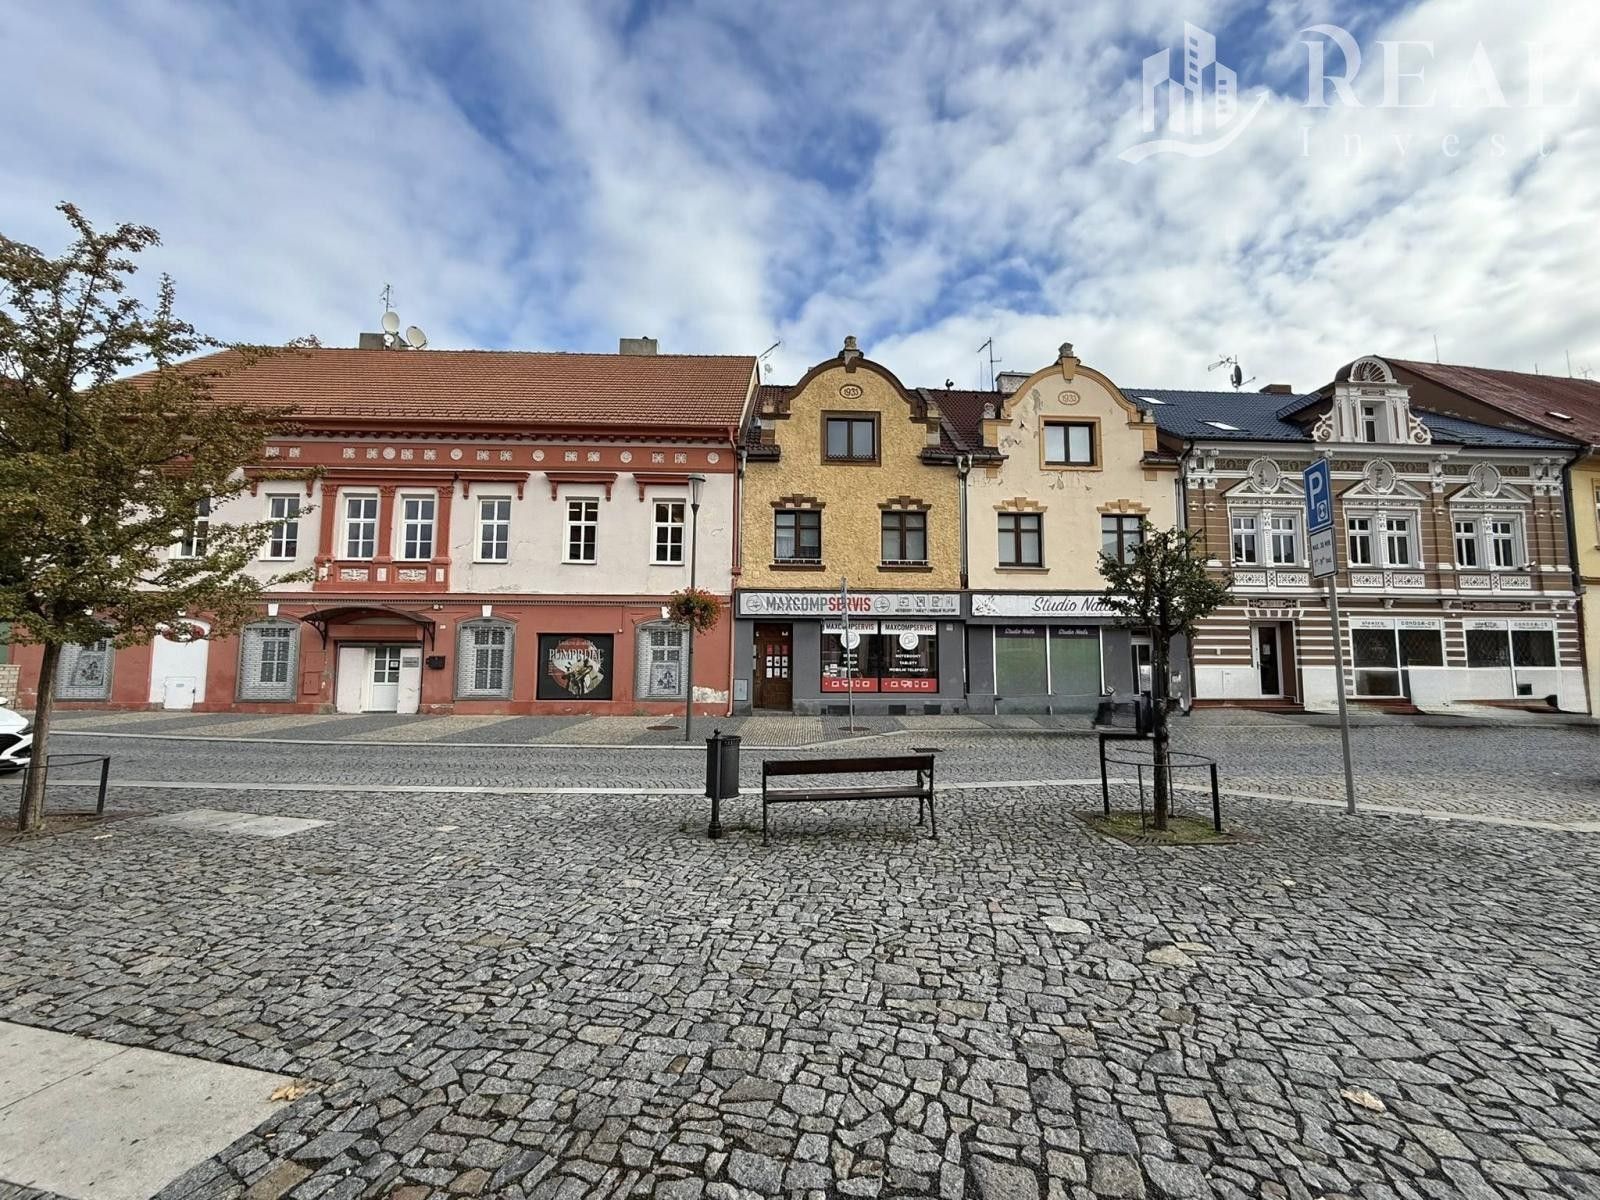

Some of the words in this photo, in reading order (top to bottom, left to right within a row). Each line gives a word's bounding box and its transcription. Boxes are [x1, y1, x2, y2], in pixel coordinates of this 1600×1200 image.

[1308, 471, 1322, 510] P
[766, 596, 871, 612] MAXCOMPSERVIS
[1032, 596, 1077, 612] Studio
[885, 623, 934, 631] MAXCOMPSERVIS
